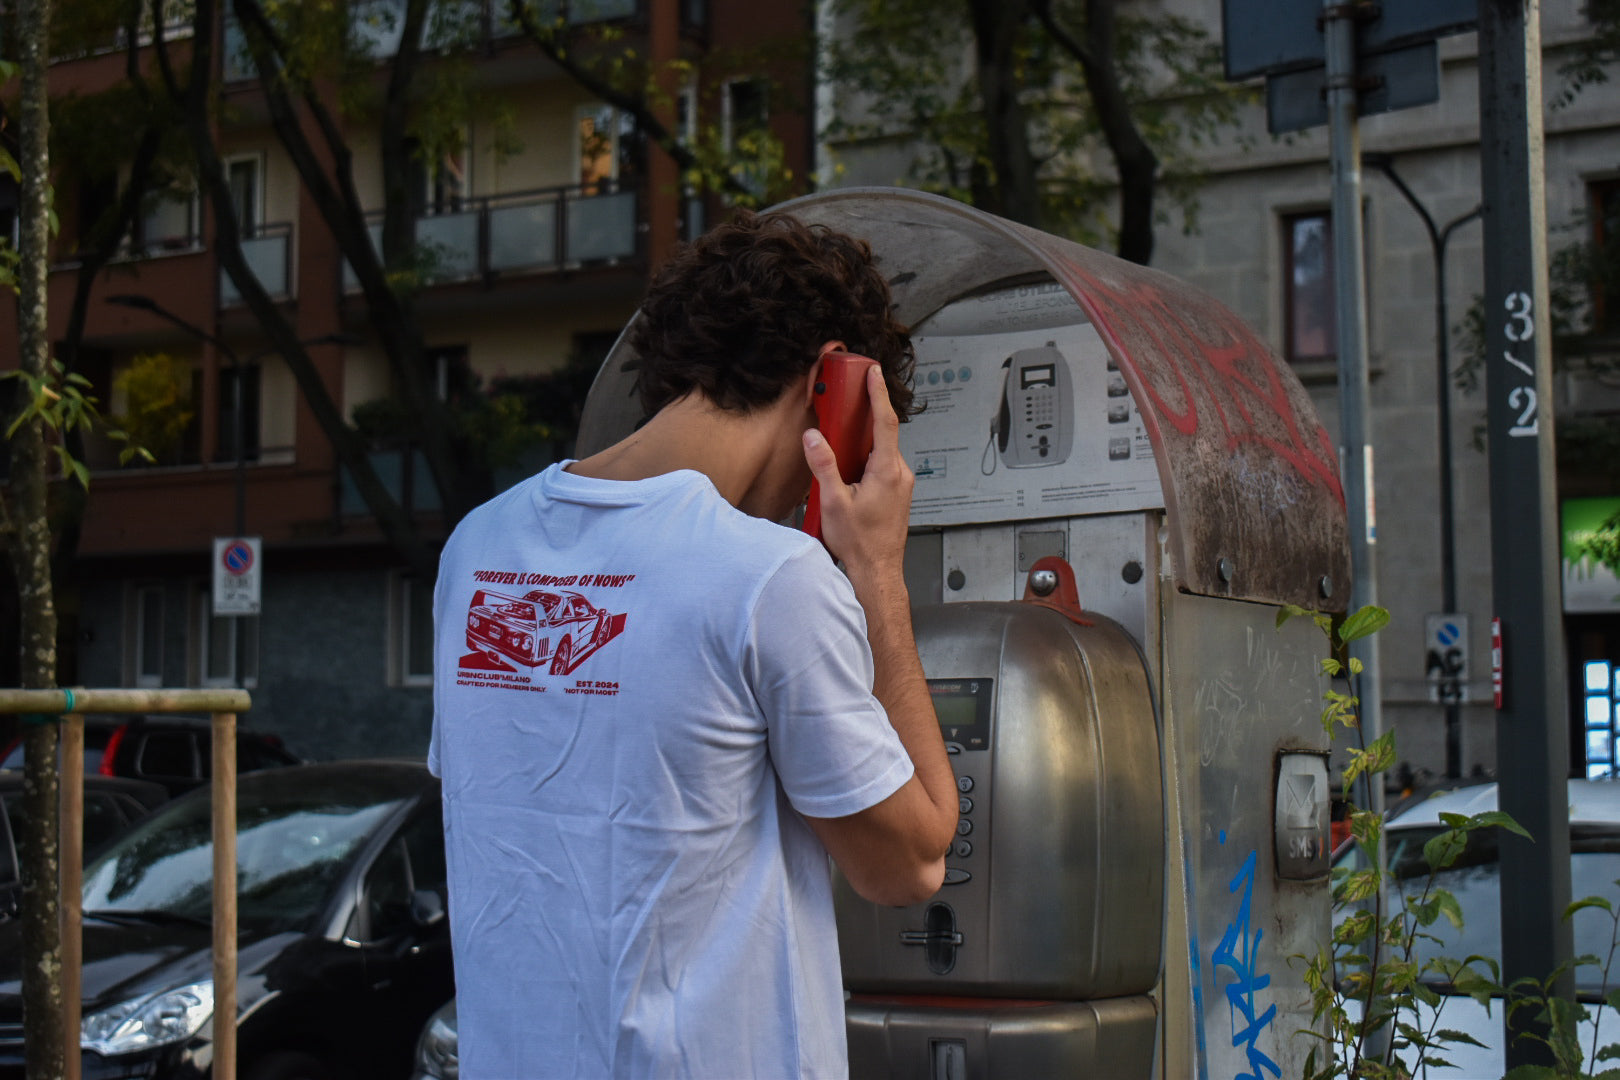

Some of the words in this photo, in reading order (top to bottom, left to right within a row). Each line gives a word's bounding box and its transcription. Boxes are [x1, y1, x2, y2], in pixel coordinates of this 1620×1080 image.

[473, 570, 518, 584] "FOREVER
[517, 572, 527, 585] IS
[526, 572, 578, 587] COMPOSED
[578, 574, 594, 587] OF
[592, 574, 636, 587] NOWS"
[500, 683, 529, 692] MEMBERS
[576, 680, 594, 688] EST.
[595, 681, 619, 689] 2024
[1289, 836, 1312, 858] SMS
